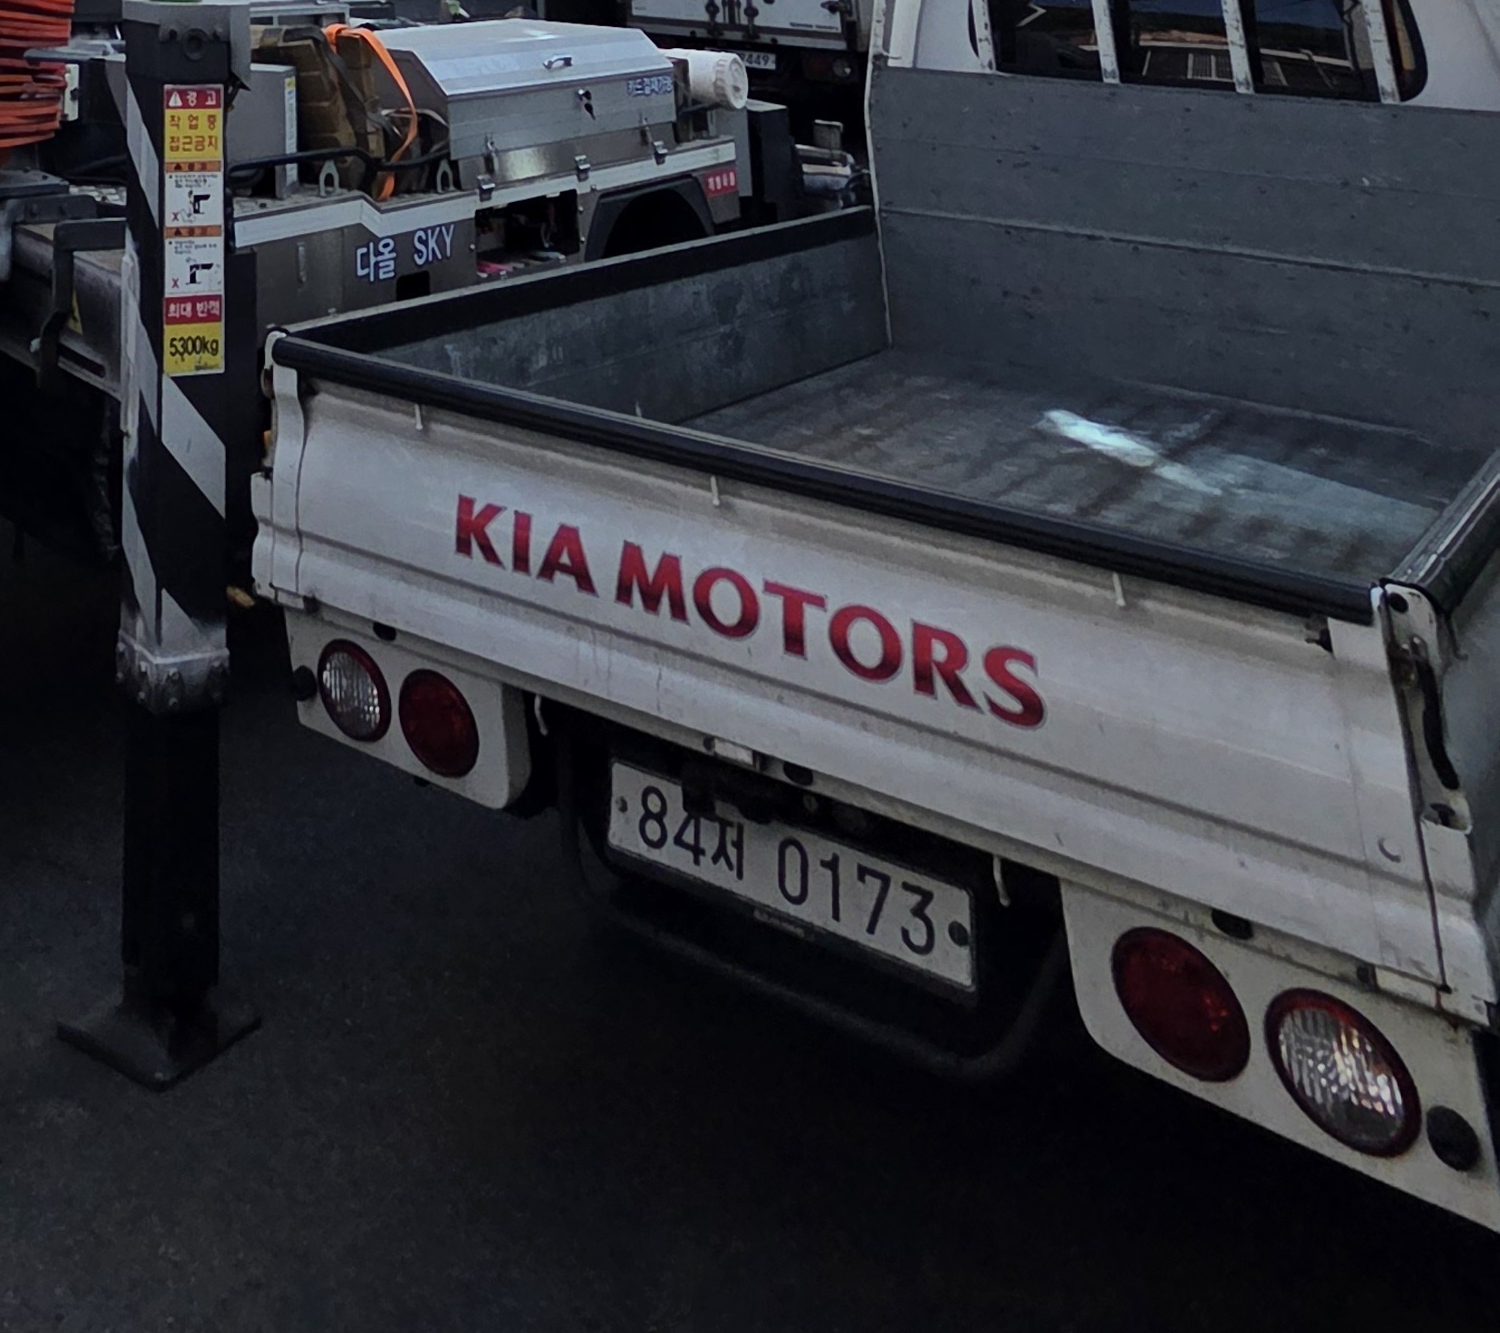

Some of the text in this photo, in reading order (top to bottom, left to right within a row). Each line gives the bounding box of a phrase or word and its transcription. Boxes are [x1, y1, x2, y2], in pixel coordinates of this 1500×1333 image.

[169, 135, 219, 153] 접근금지
[356, 223, 455, 283] 다올 SKY
[167, 302, 192, 318] 최대
[169, 336, 219, 358] 5300kg
[453, 493, 1047, 731] KIA MOTORS
[638, 785, 936, 956] 84저 0173
